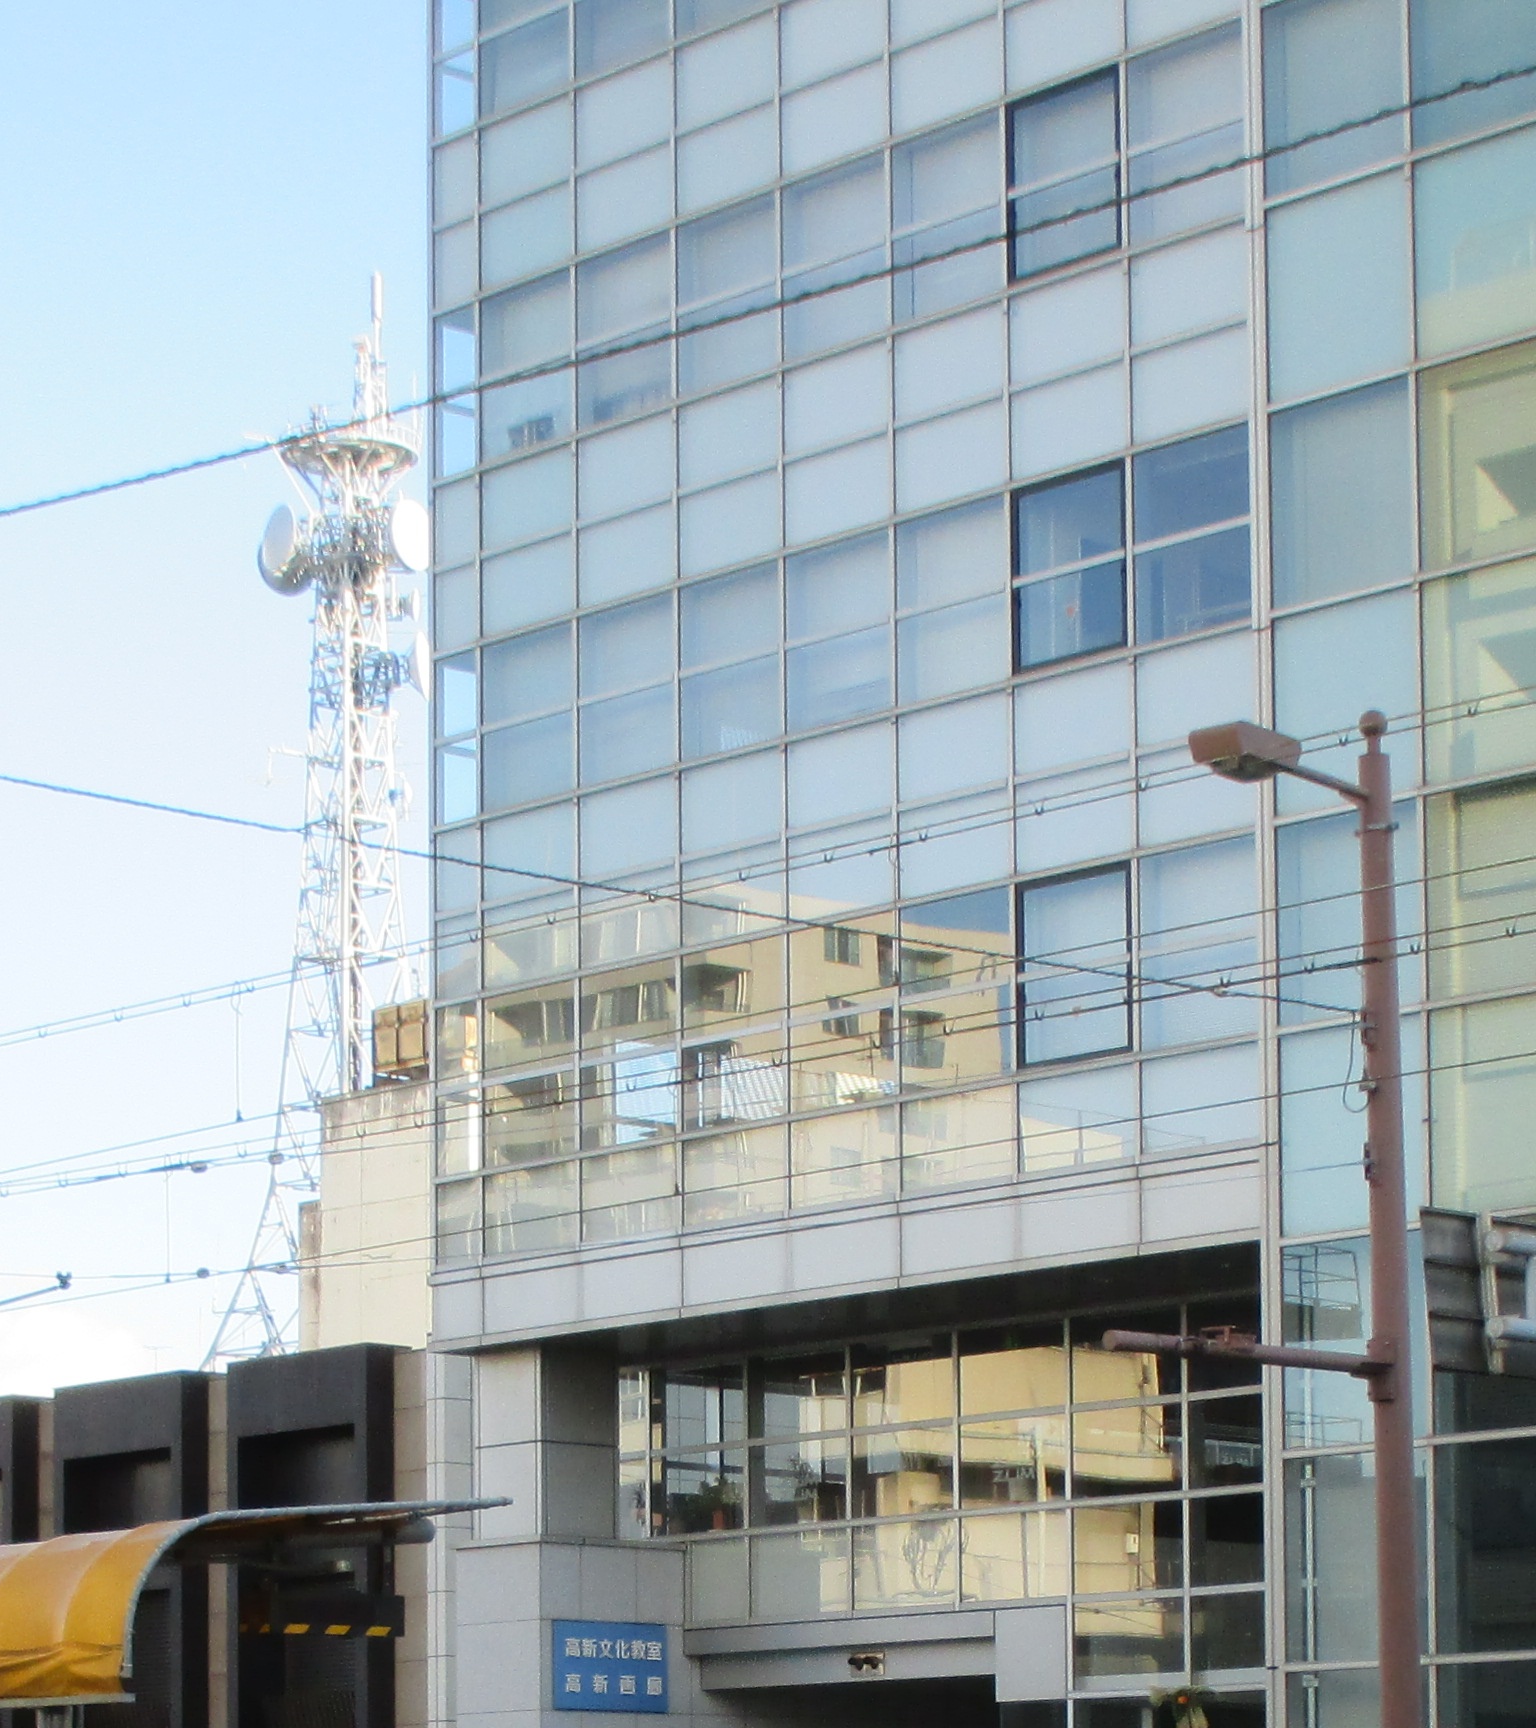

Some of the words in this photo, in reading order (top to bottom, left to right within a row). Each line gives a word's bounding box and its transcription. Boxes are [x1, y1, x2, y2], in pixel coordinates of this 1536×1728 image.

[564, 1637, 663, 1661] 高新文化教室
[564, 1673, 663, 1696] 高新画廊
